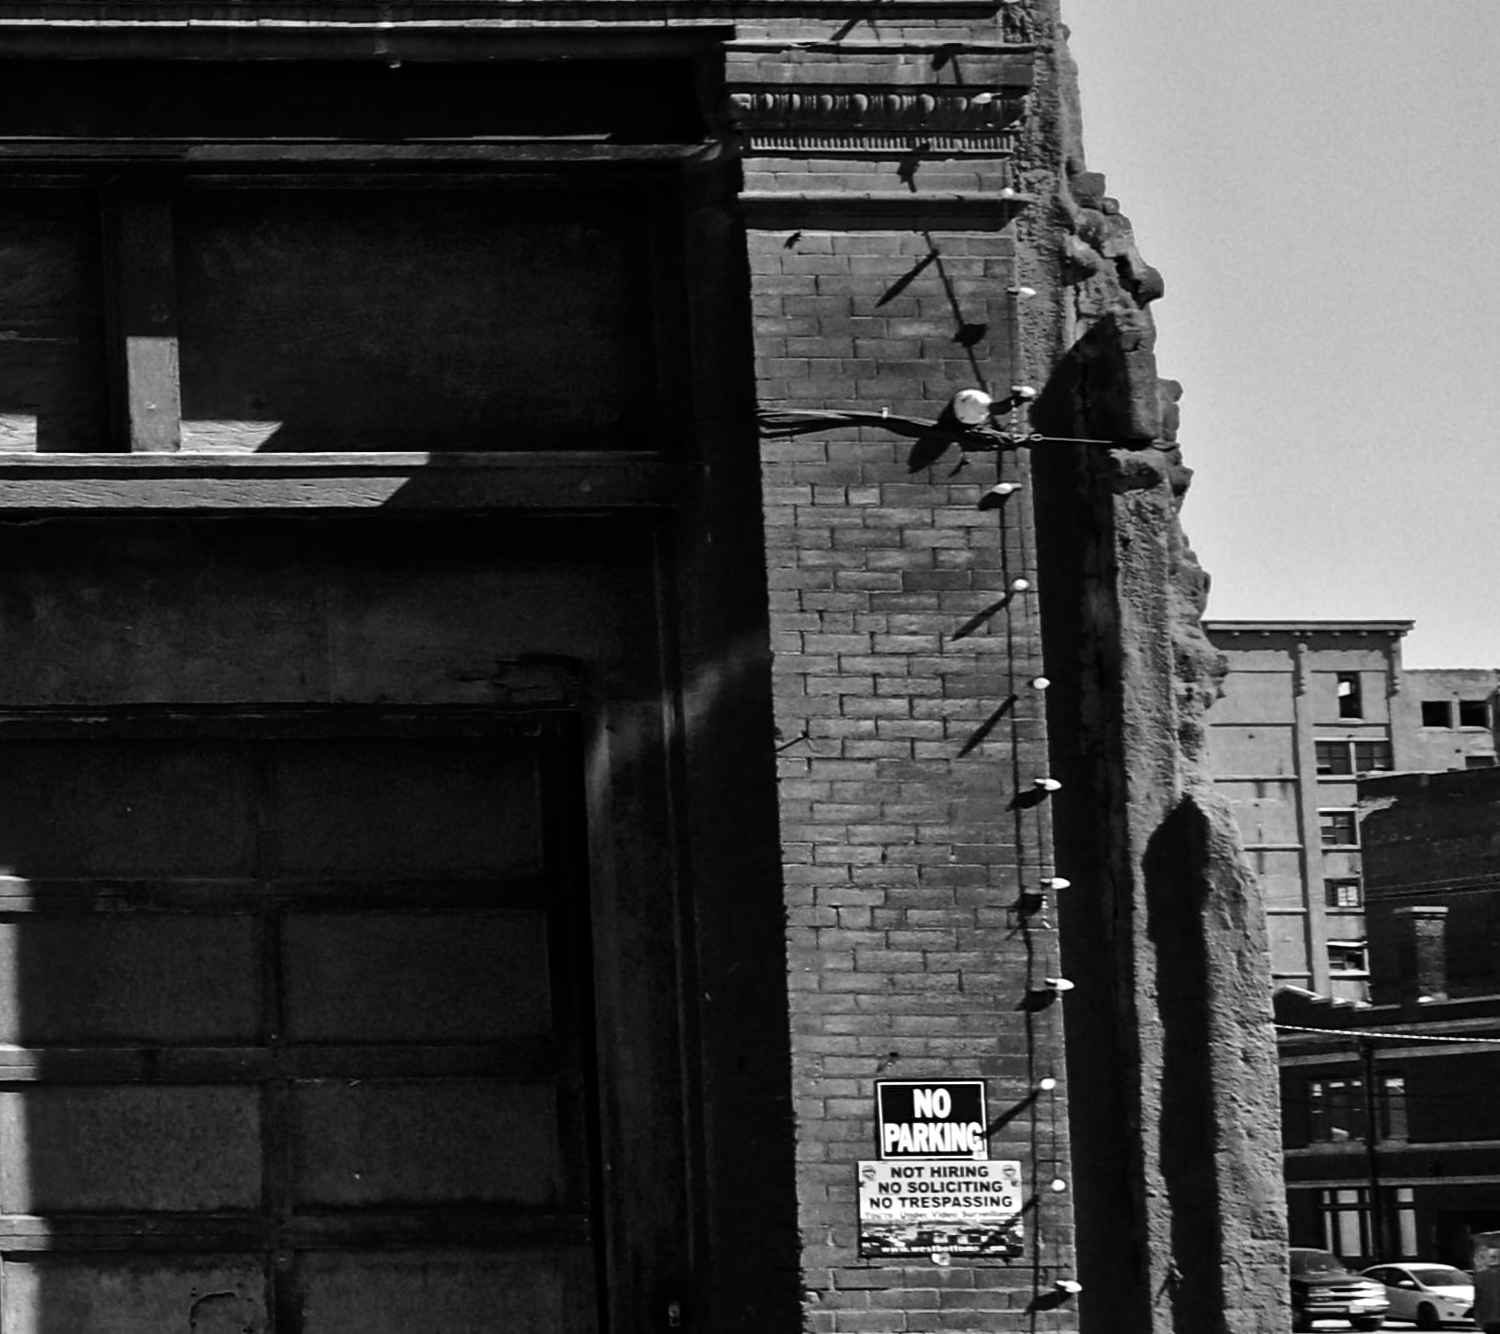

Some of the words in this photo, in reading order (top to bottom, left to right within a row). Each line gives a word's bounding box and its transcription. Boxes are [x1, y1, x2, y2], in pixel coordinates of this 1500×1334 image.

[913, 1088, 952, 1119] NO
[884, 1121, 984, 1153] PARKING
[890, 1166, 925, 1179] NOT
[930, 1166, 990, 1178] HIRING
[878, 1181, 902, 1194] NO
[907, 1180, 1004, 1193] SOLICITING
[869, 1197, 894, 1209] NO
[897, 1196, 1014, 1208] TRESPASSING
